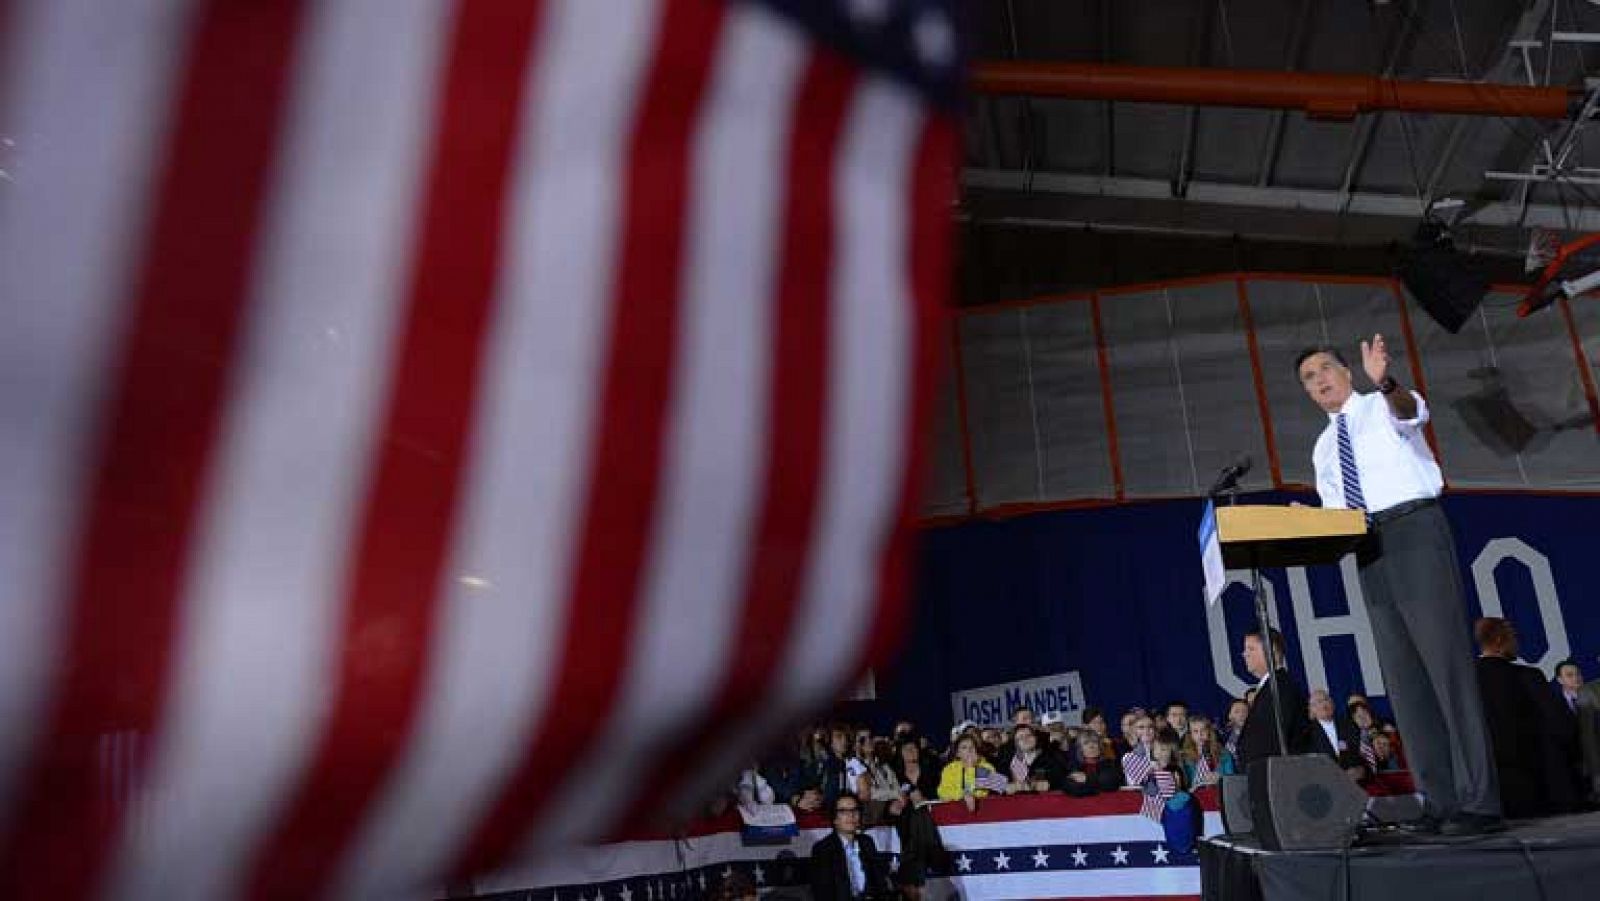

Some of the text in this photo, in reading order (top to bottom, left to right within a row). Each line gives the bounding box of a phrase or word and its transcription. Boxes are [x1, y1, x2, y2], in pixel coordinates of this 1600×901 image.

[1205, 537, 1570, 699] OHO
[959, 684, 1078, 724] JOSH MANDEL
